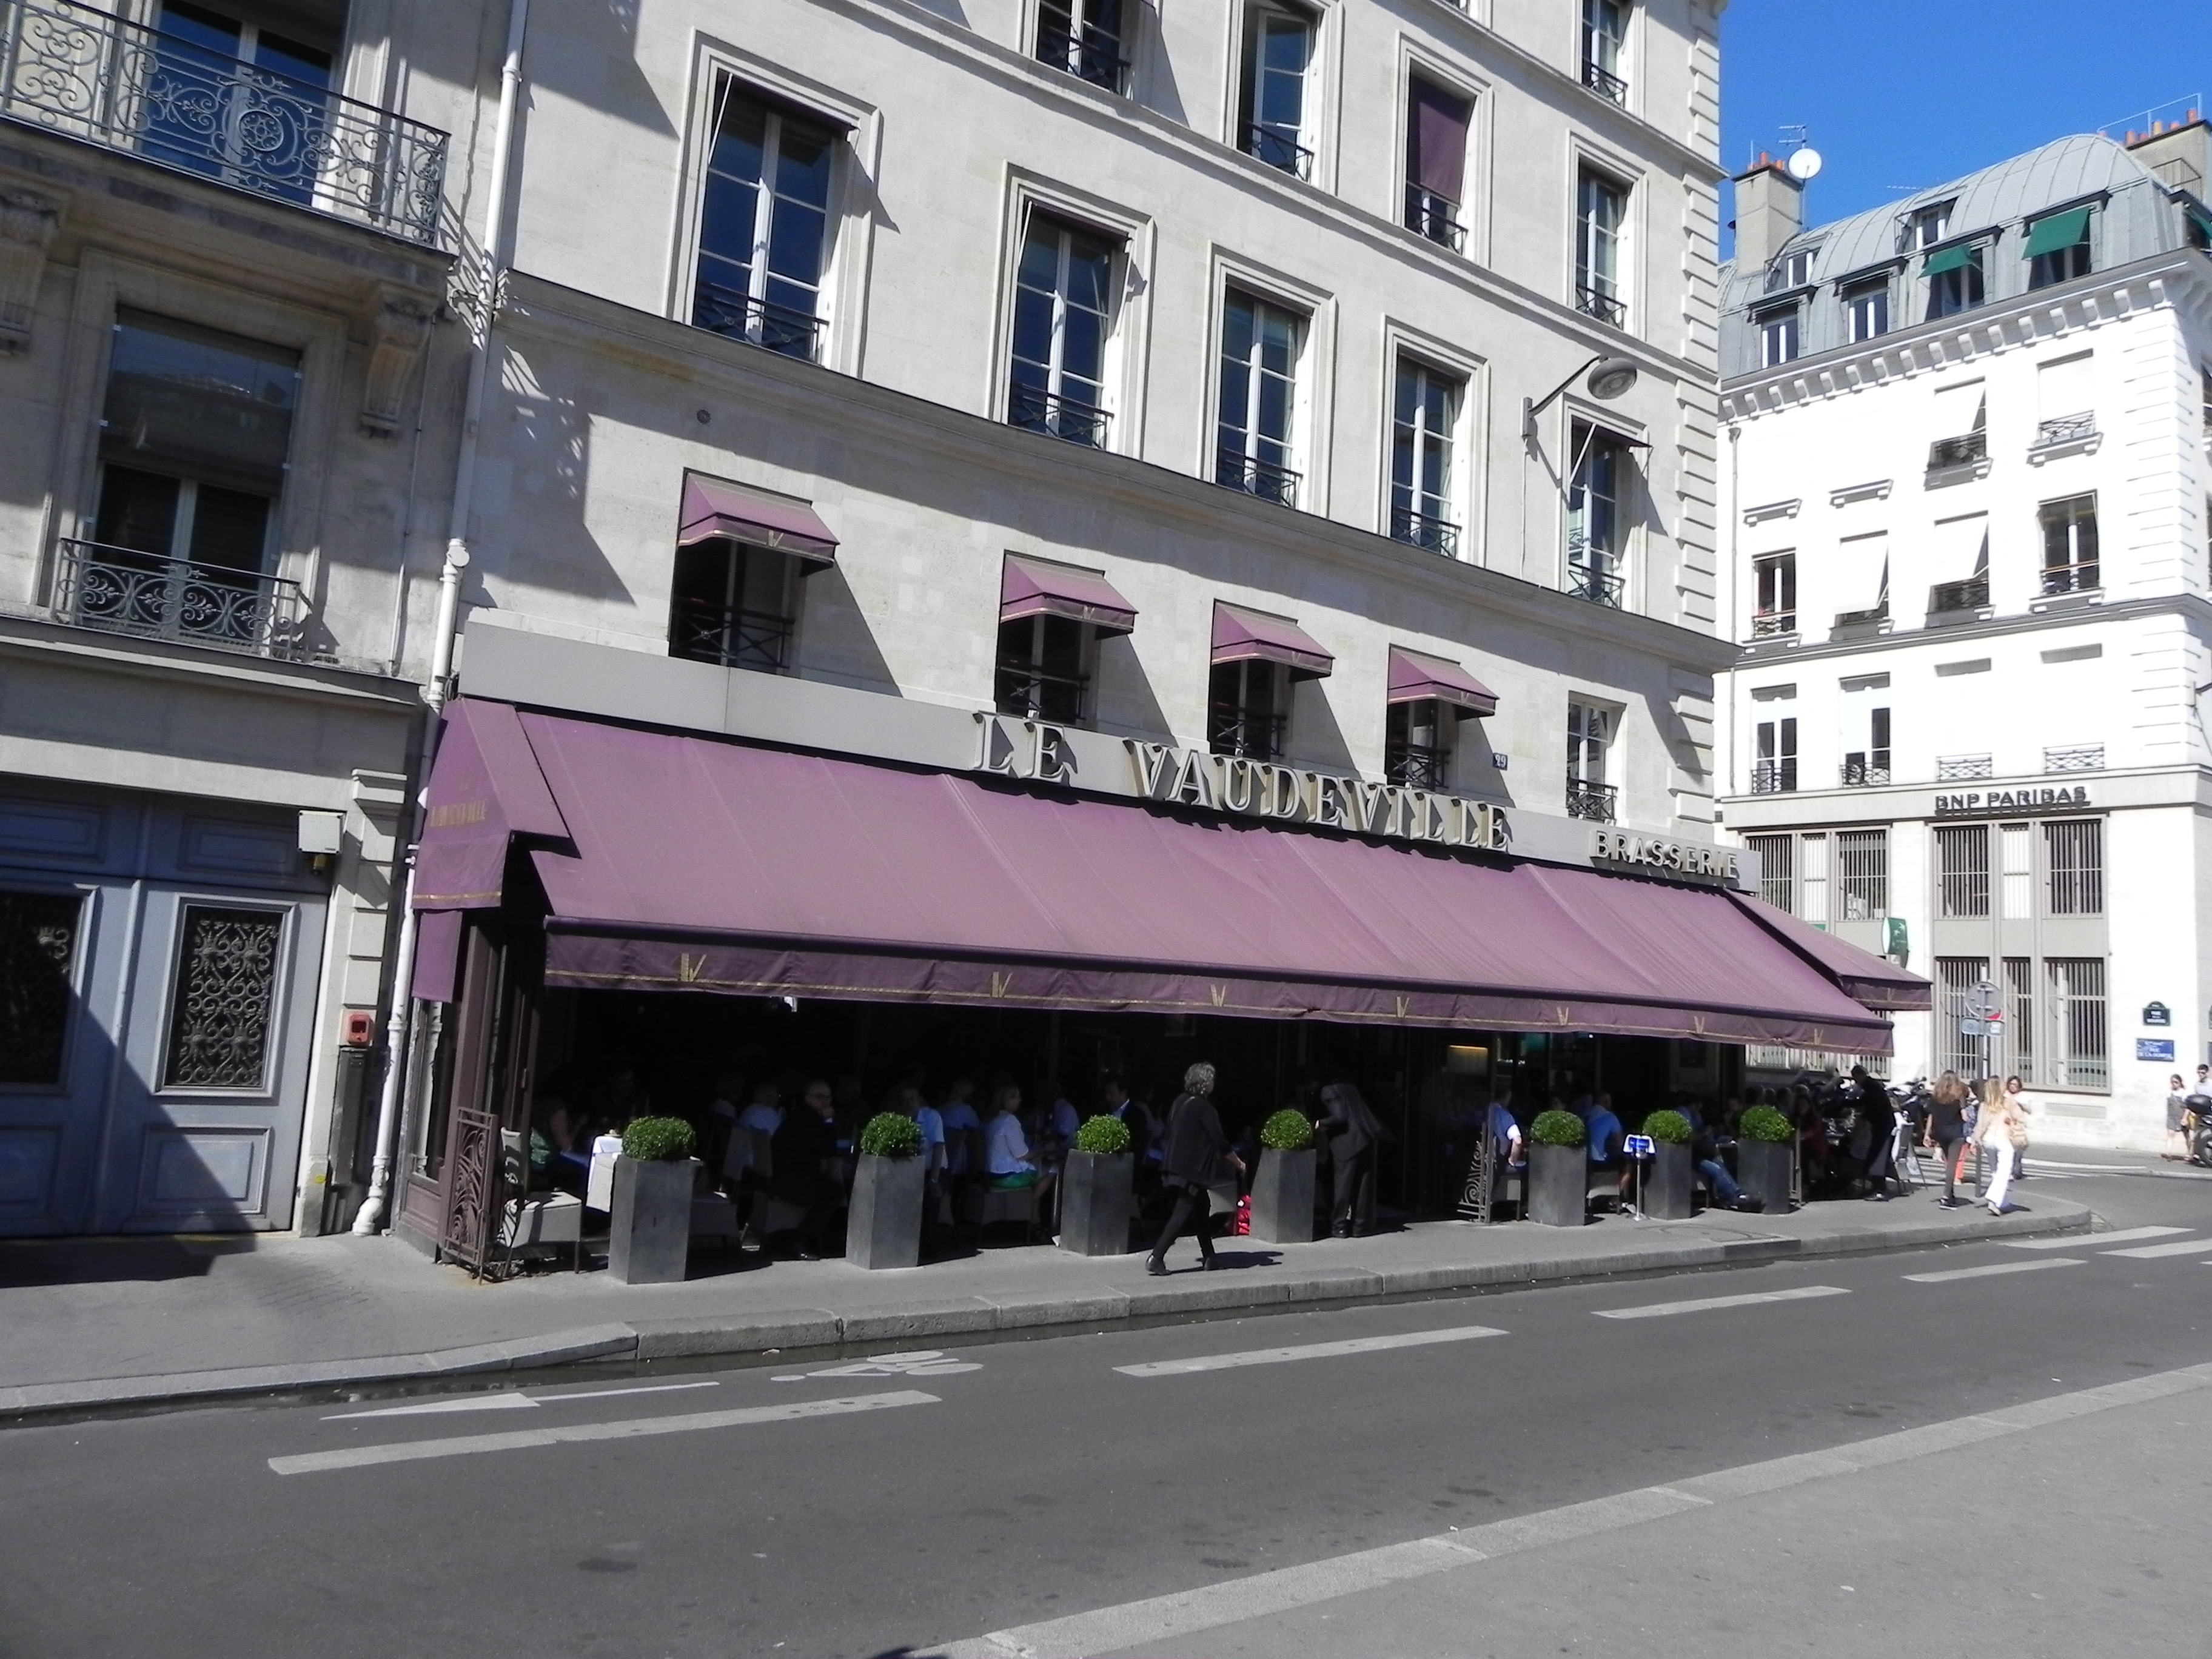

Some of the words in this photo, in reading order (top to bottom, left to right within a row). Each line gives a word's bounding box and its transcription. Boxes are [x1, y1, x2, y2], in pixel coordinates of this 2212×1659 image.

[1495, 754, 1506, 768] 29
[973, 711, 1067, 783] LE
[1123, 737, 1510, 853] VAUDEVILLE
[1935, 793, 1980, 811] BNP
[1987, 786, 2087, 808] PARIBAS
[1591, 830, 1738, 879] BRASSERIE
